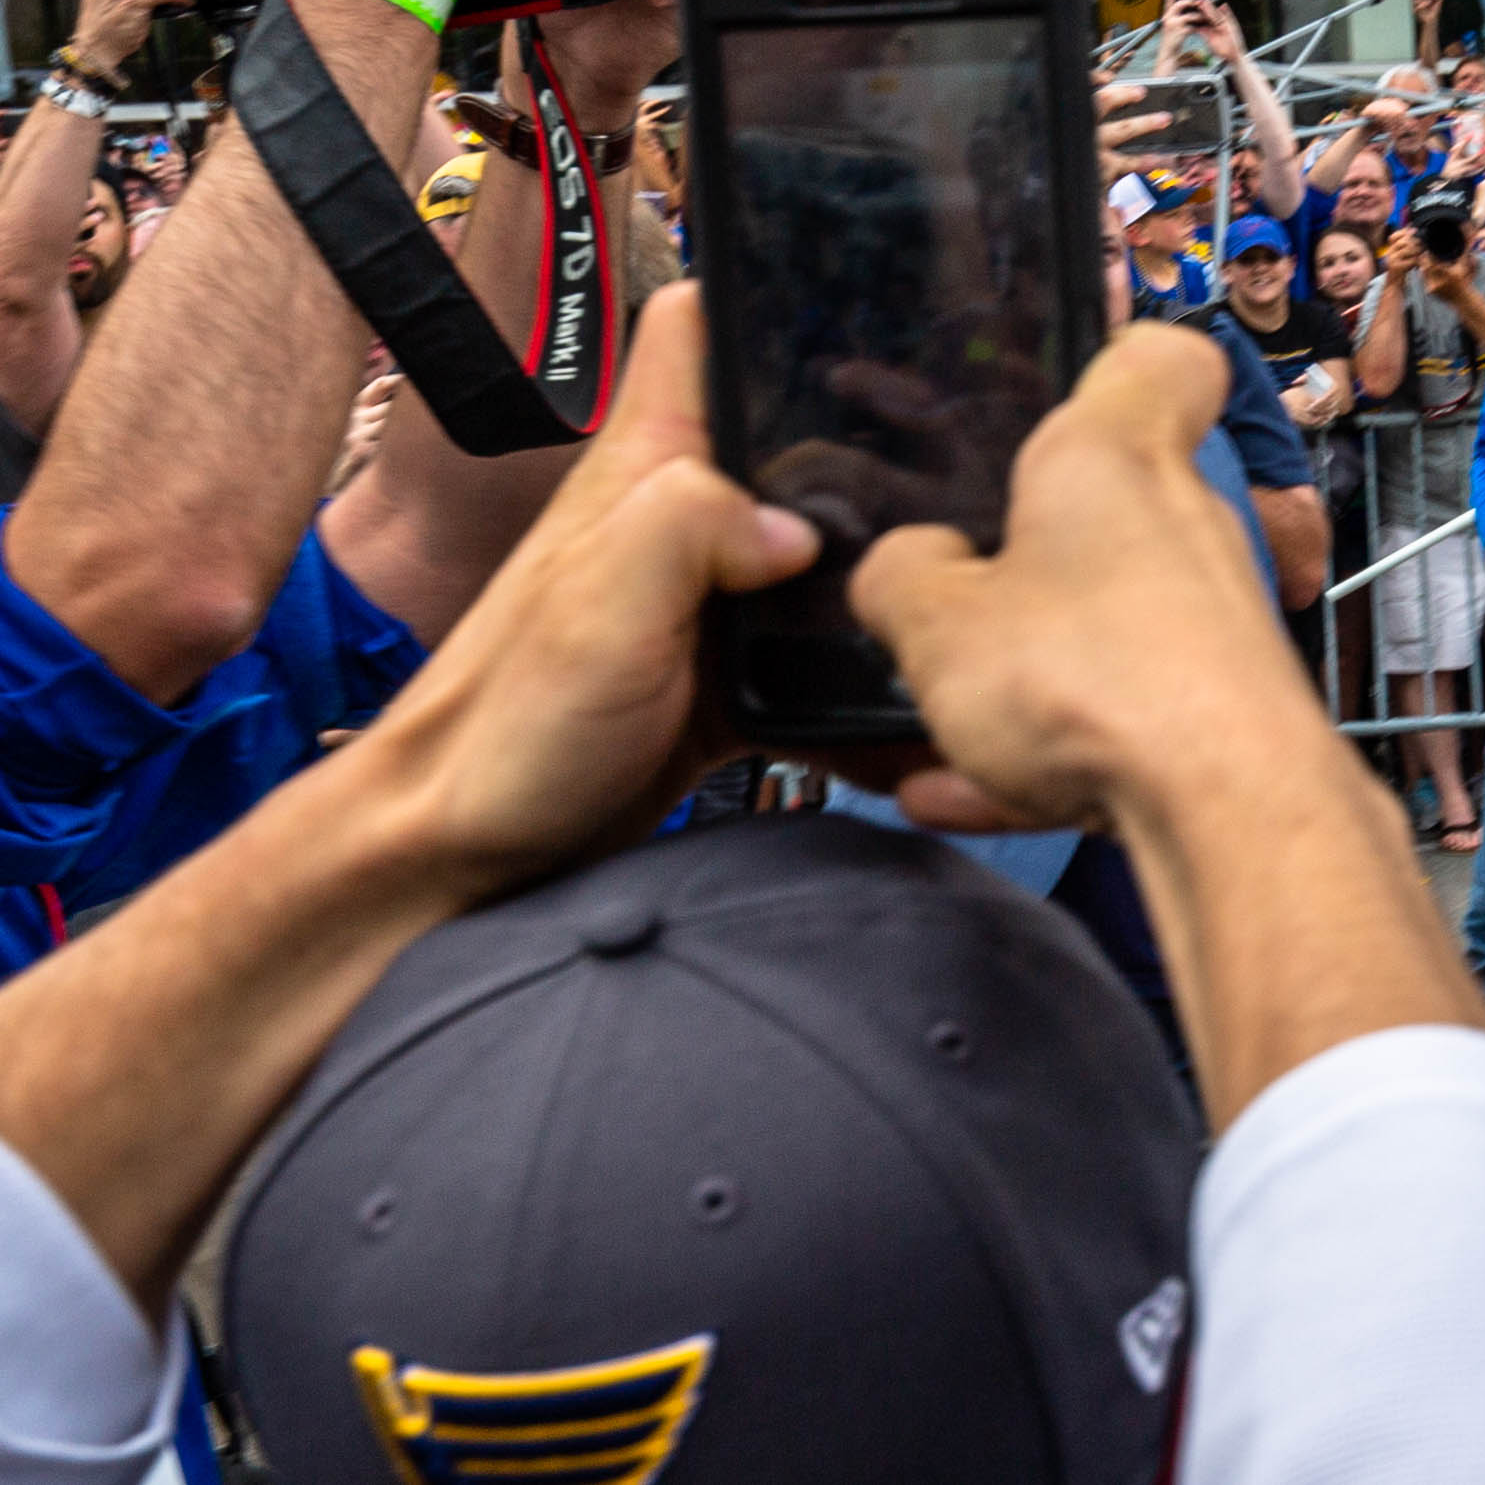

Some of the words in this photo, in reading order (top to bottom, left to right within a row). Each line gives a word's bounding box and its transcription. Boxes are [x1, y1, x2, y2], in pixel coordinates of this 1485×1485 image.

[539, 88, 588, 210] EOS
[560, 215, 596, 282] 7D
[549, 292, 586, 365] Mark
